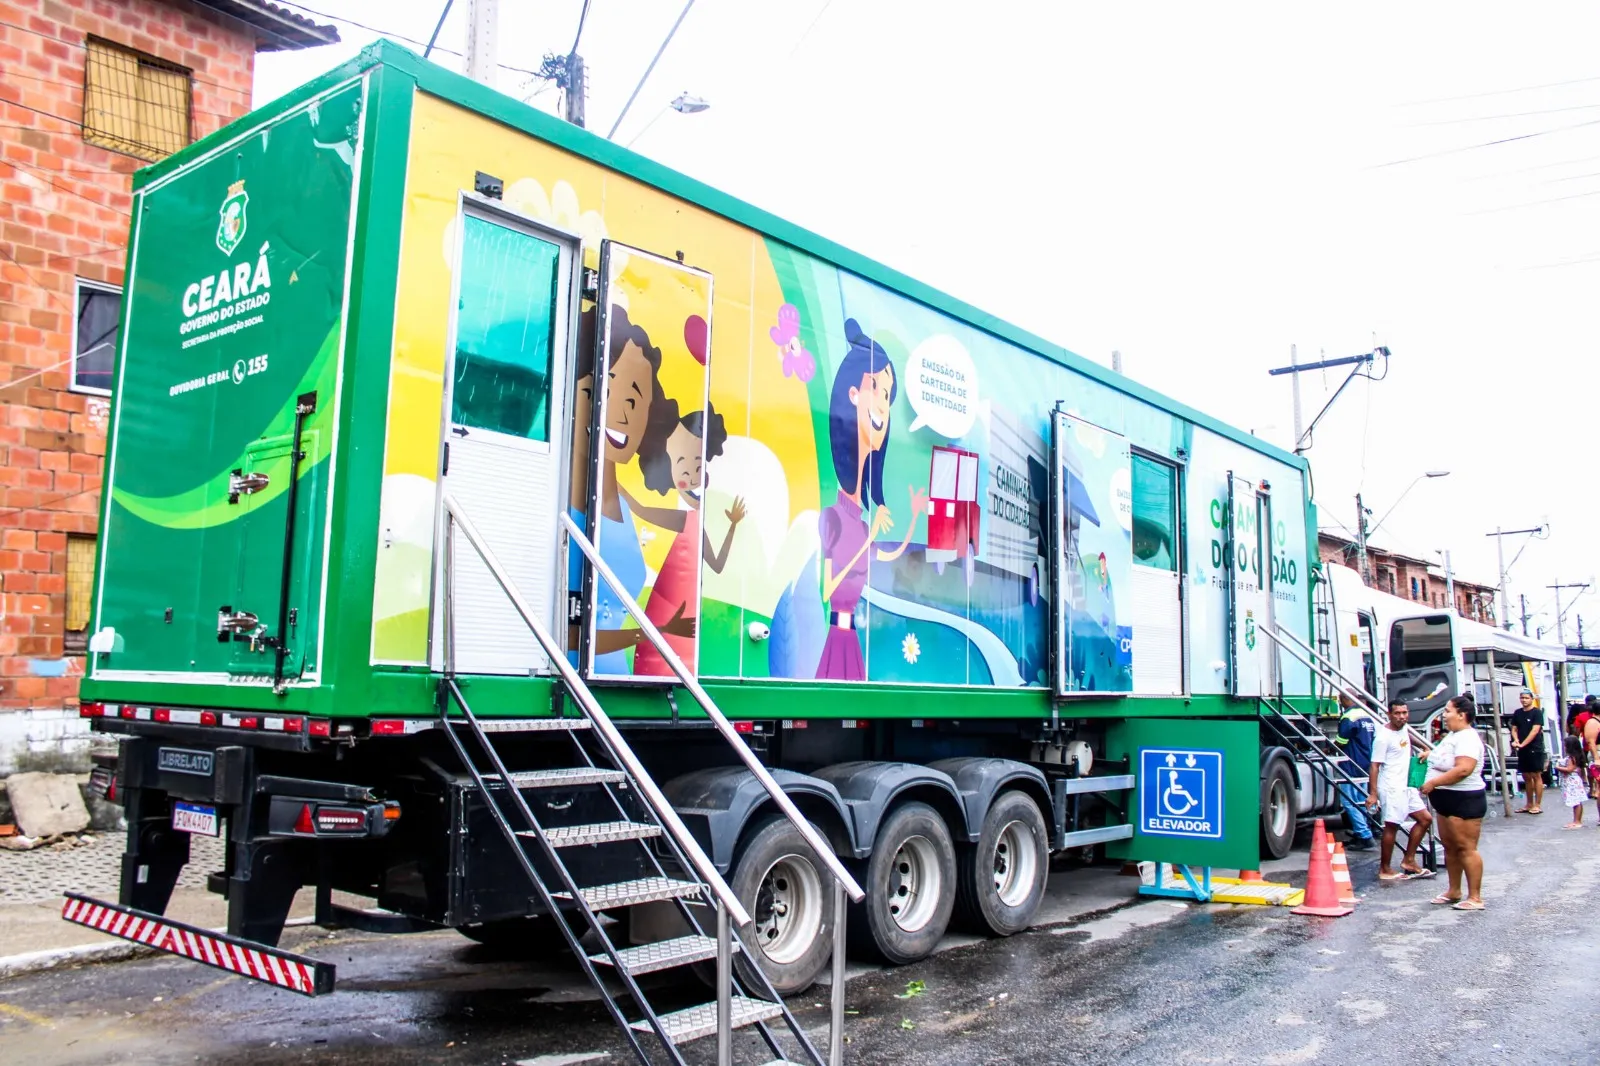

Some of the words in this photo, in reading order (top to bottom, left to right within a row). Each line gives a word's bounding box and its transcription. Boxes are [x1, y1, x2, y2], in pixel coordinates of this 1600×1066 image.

[182, 240, 271, 318] CEARÁ
[180, 311, 219, 334] GOVERNO
[220, 305, 234, 320] DO
[235, 292, 270, 315] ESTADO
[182, 334, 210, 349] SECRETARIA
[209, 331, 217, 340] DA
[216, 320, 244, 337] PROTEÇÃO
[244, 314, 264, 328] SOCIAL
[169, 376, 206, 397] OUVIDORIA
[206, 369, 230, 386] GERAL
[247, 353, 269, 376] 155
[920, 373, 957, 396] CARTEIRA
[957, 387, 967, 399] DE
[955, 371, 966, 383] DA
[921, 390, 967, 415] IDENTIDADE
[993, 494, 1004, 518] DO
[160, 751, 210, 771] LIBRELATO
[1148, 818, 1211, 833] ELEVADOR
